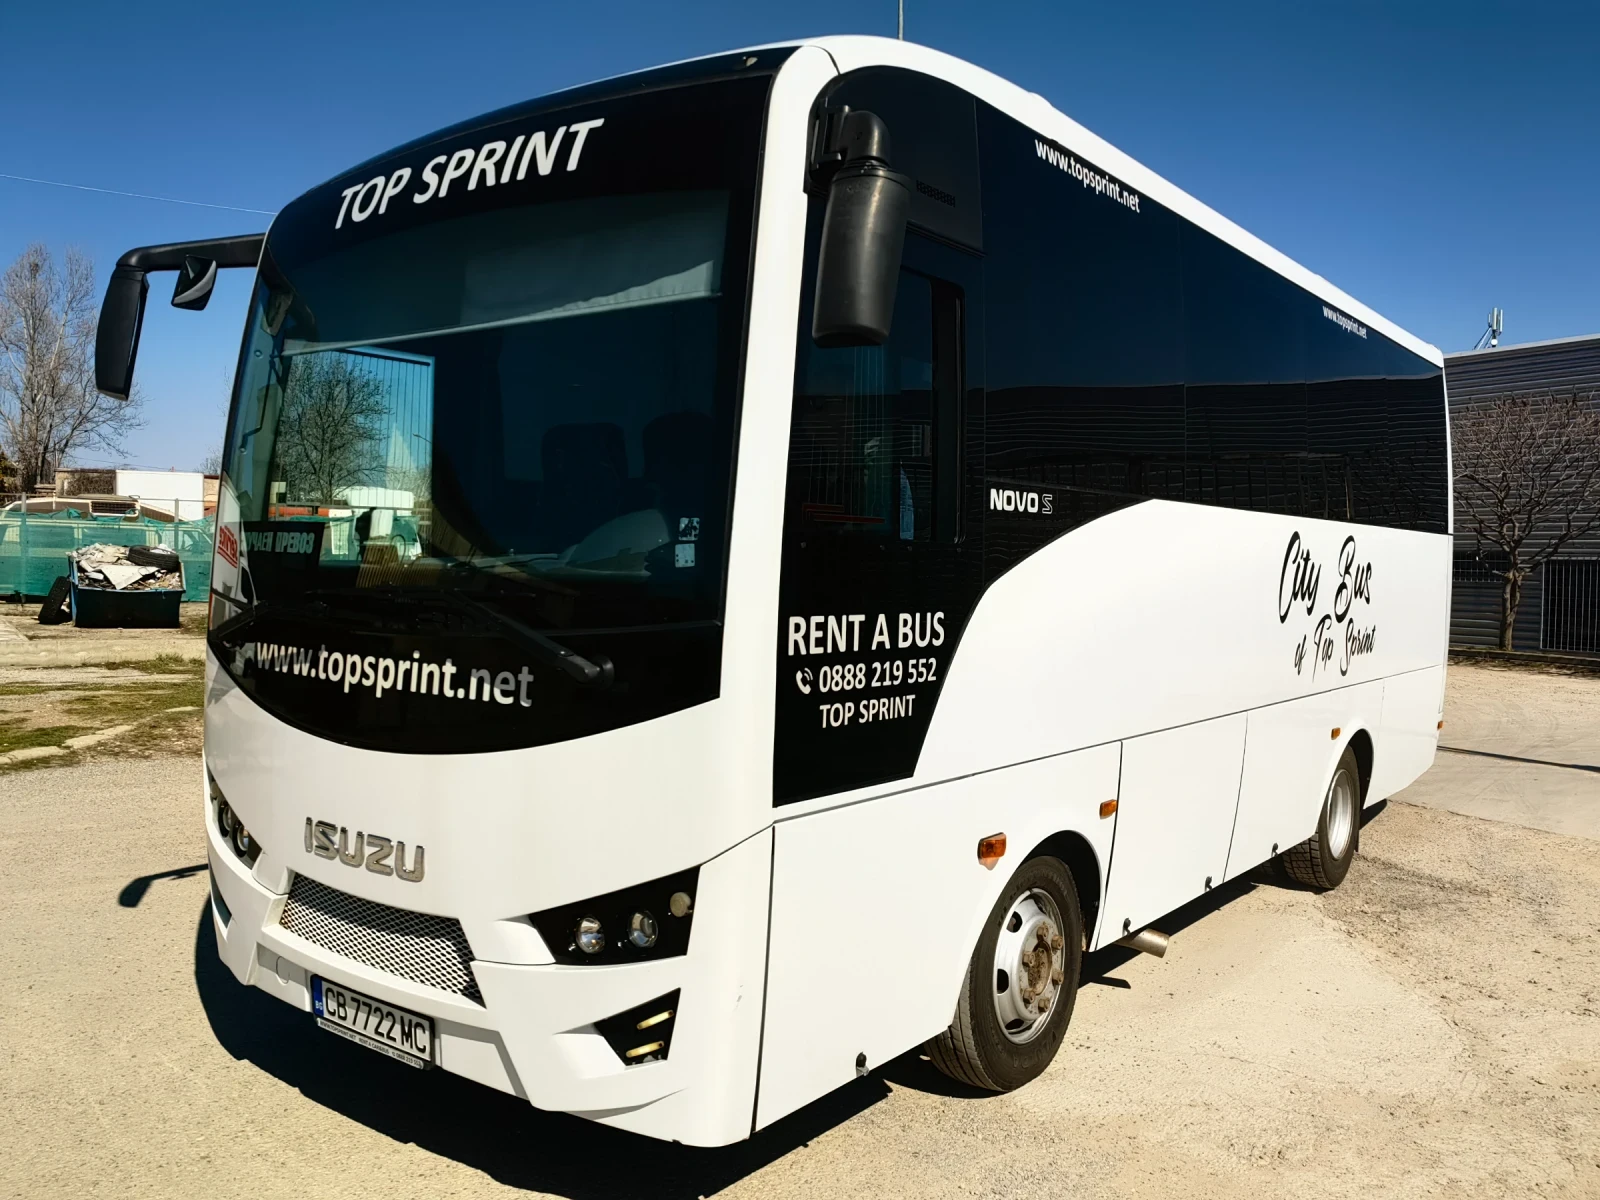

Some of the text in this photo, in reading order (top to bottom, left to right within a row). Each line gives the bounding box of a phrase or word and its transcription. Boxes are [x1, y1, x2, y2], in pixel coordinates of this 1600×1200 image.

[335, 117, 606, 230] TOP SPRINT
[1034, 139, 1141, 214] www.topsprint.net
[1322, 305, 1368, 340] www.topsprint.net
[990, 488, 1039, 513] NOVO
[275, 531, 316, 554] ПРЕВОЗ
[1278, 530, 1372, 624] City Bus
[788, 611, 945, 656] RENT A BUS
[1312, 613, 1334, 683] Top
[1339, 617, 1376, 677] Sprint
[256, 641, 534, 708] www.topsprint.net
[818, 657, 938, 694] 0888 219 552
[819, 694, 916, 729] TOP SPRINT
[304, 816, 426, 883] ISUZU
[325, 987, 427, 1054] CB 7722 MC
